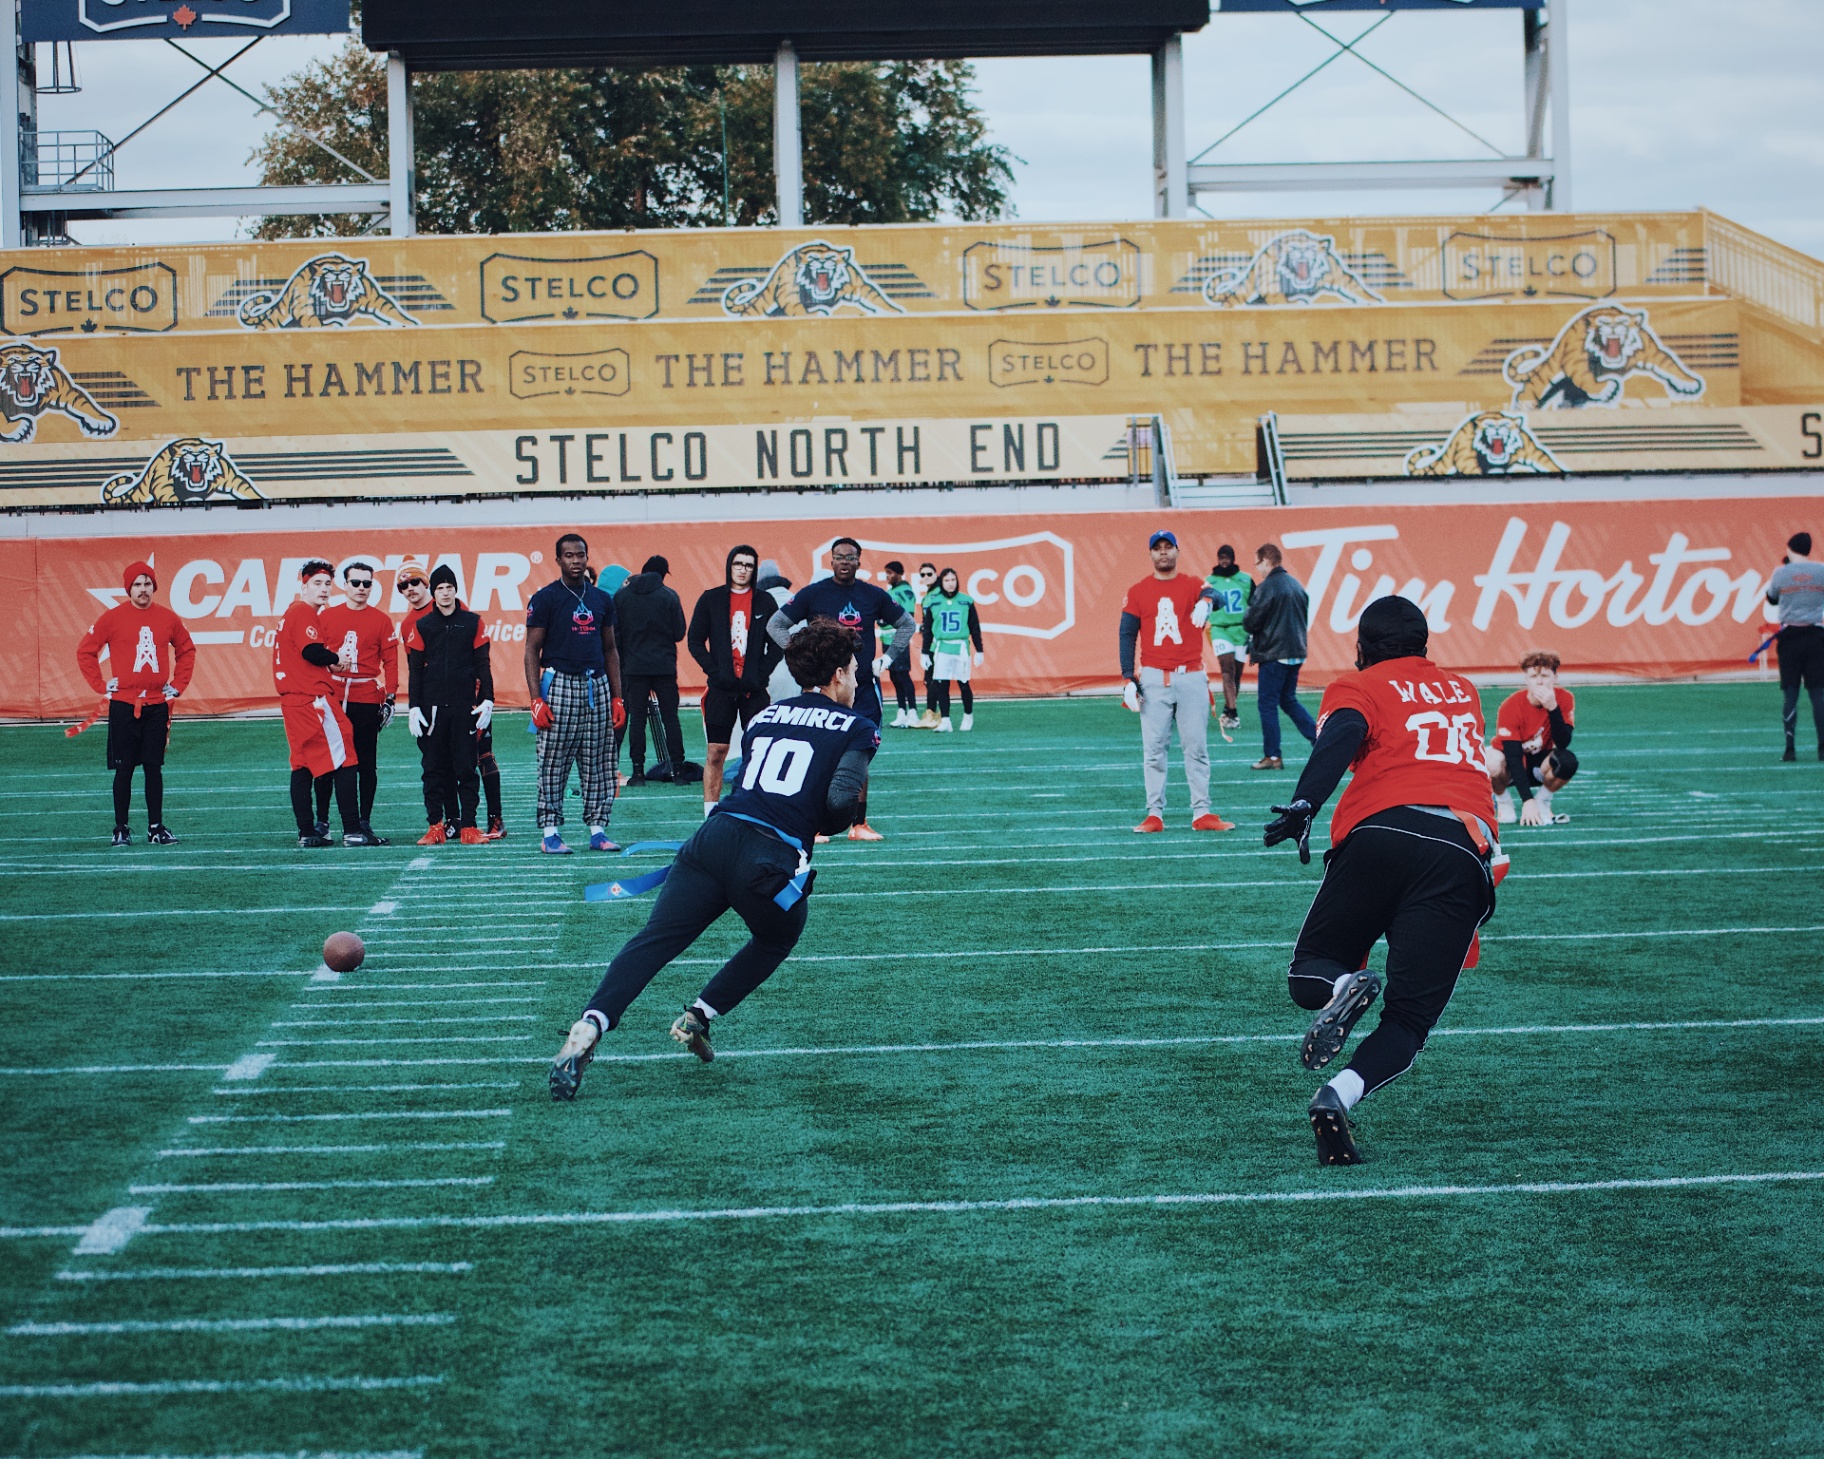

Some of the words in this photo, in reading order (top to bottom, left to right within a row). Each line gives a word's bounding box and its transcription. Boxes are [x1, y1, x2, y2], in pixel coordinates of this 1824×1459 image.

[983, 261, 1122, 291] STELCO
[1462, 251, 1597, 282] STELCO
[20, 284, 159, 316] STELCO
[501, 272, 640, 303] STELCO
[655, 353, 744, 388] THE
[764, 348, 964, 385] HAMMER
[1002, 352, 1096, 373] STELCO
[1134, 343, 1222, 377] THE
[1242, 338, 1438, 375] HAMMER
[176, 366, 266, 401] THE
[283, 359, 484, 398] HAMMER
[522, 363, 617, 384] STELCO
[516, 432, 708, 485] STELCO
[757, 425, 921, 480] NORTH
[970, 422, 1060, 473] END
[1281, 525, 1455, 633] Tim
[1472, 516, 1780, 632] Horton
[1223, 589, 1243, 614] 12
[940, 611, 961, 633] 15
[1389, 679, 1472, 705] WALE
[741, 736, 815, 797] 10
